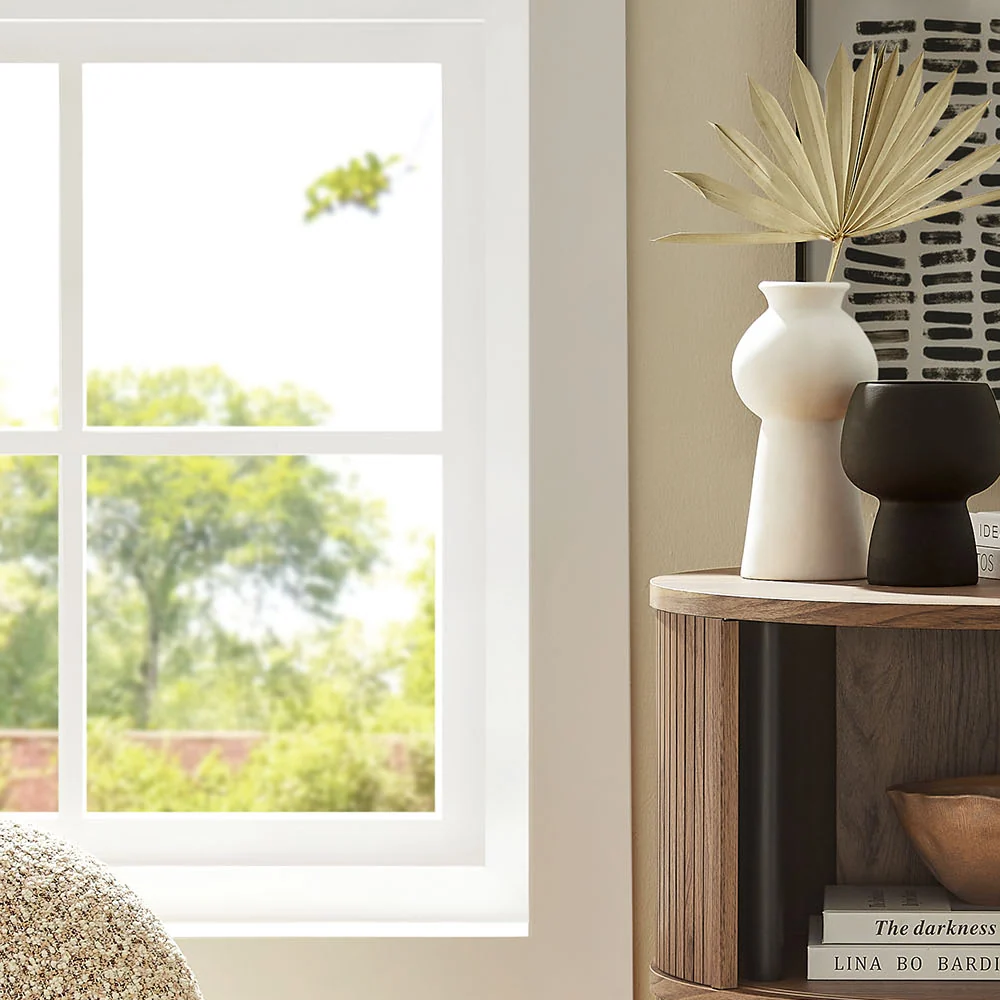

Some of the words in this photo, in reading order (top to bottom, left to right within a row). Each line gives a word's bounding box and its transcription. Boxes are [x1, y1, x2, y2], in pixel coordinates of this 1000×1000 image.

[977, 552, 994, 572] OS
[875, 919, 909, 936] The
[913, 919, 997, 936] darkness
[834, 956, 882, 971] LINA
[896, 956, 922, 971] BO
[937, 956, 1000, 971] BARDI
